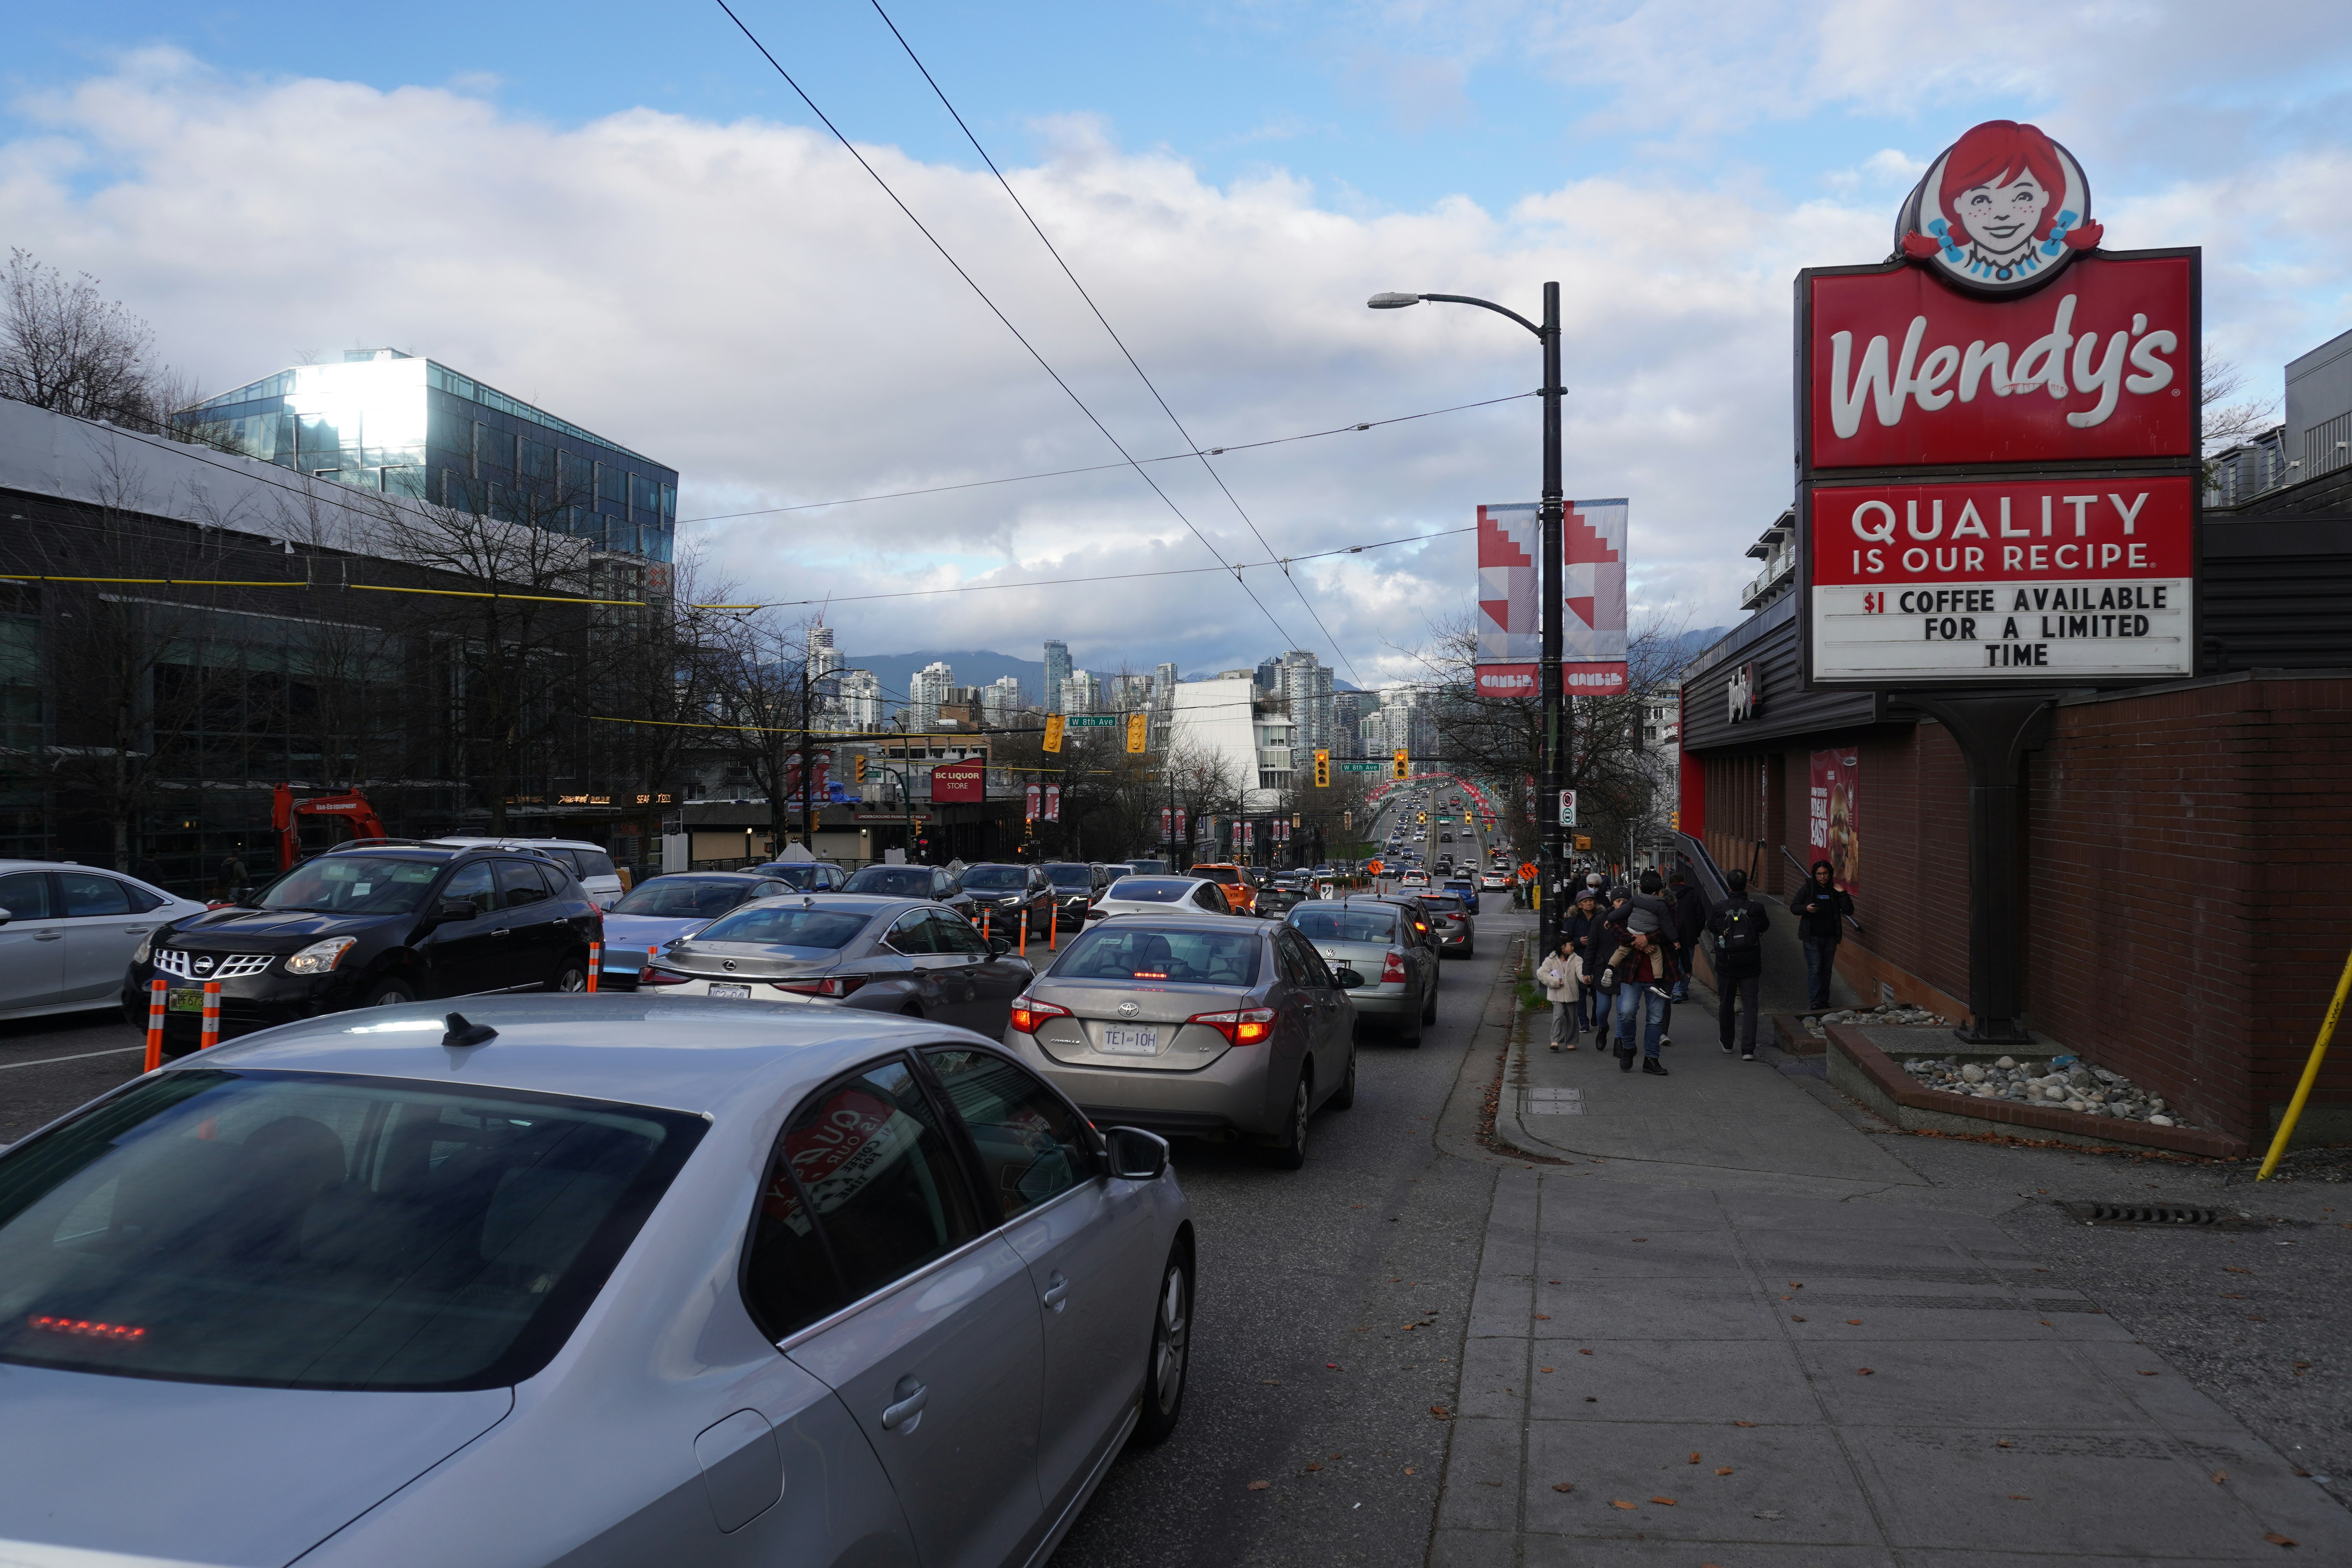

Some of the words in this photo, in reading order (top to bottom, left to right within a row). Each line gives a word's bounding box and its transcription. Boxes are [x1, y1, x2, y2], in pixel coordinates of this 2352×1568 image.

[1830, 294, 2178, 439] Wendy's
[1851, 492, 2150, 546] QUALITY
[1853, 548, 1884, 574] IS
[1902, 546, 1985, 573] OUR
[2004, 543, 2148, 571] RECIPE
[1864, 591, 1884, 614] $1
[1899, 589, 1994, 613] COFFEE
[2014, 586, 2167, 612] AVAILABLE
[1925, 617, 1976, 641] FOR
[2003, 616, 2019, 639] A
[2042, 614, 2149, 639] LIMITED
[1985, 644, 2048, 666] TIME
[1811, 797, 1827, 819] BREAK
[1811, 818, 1827, 848] FAST
